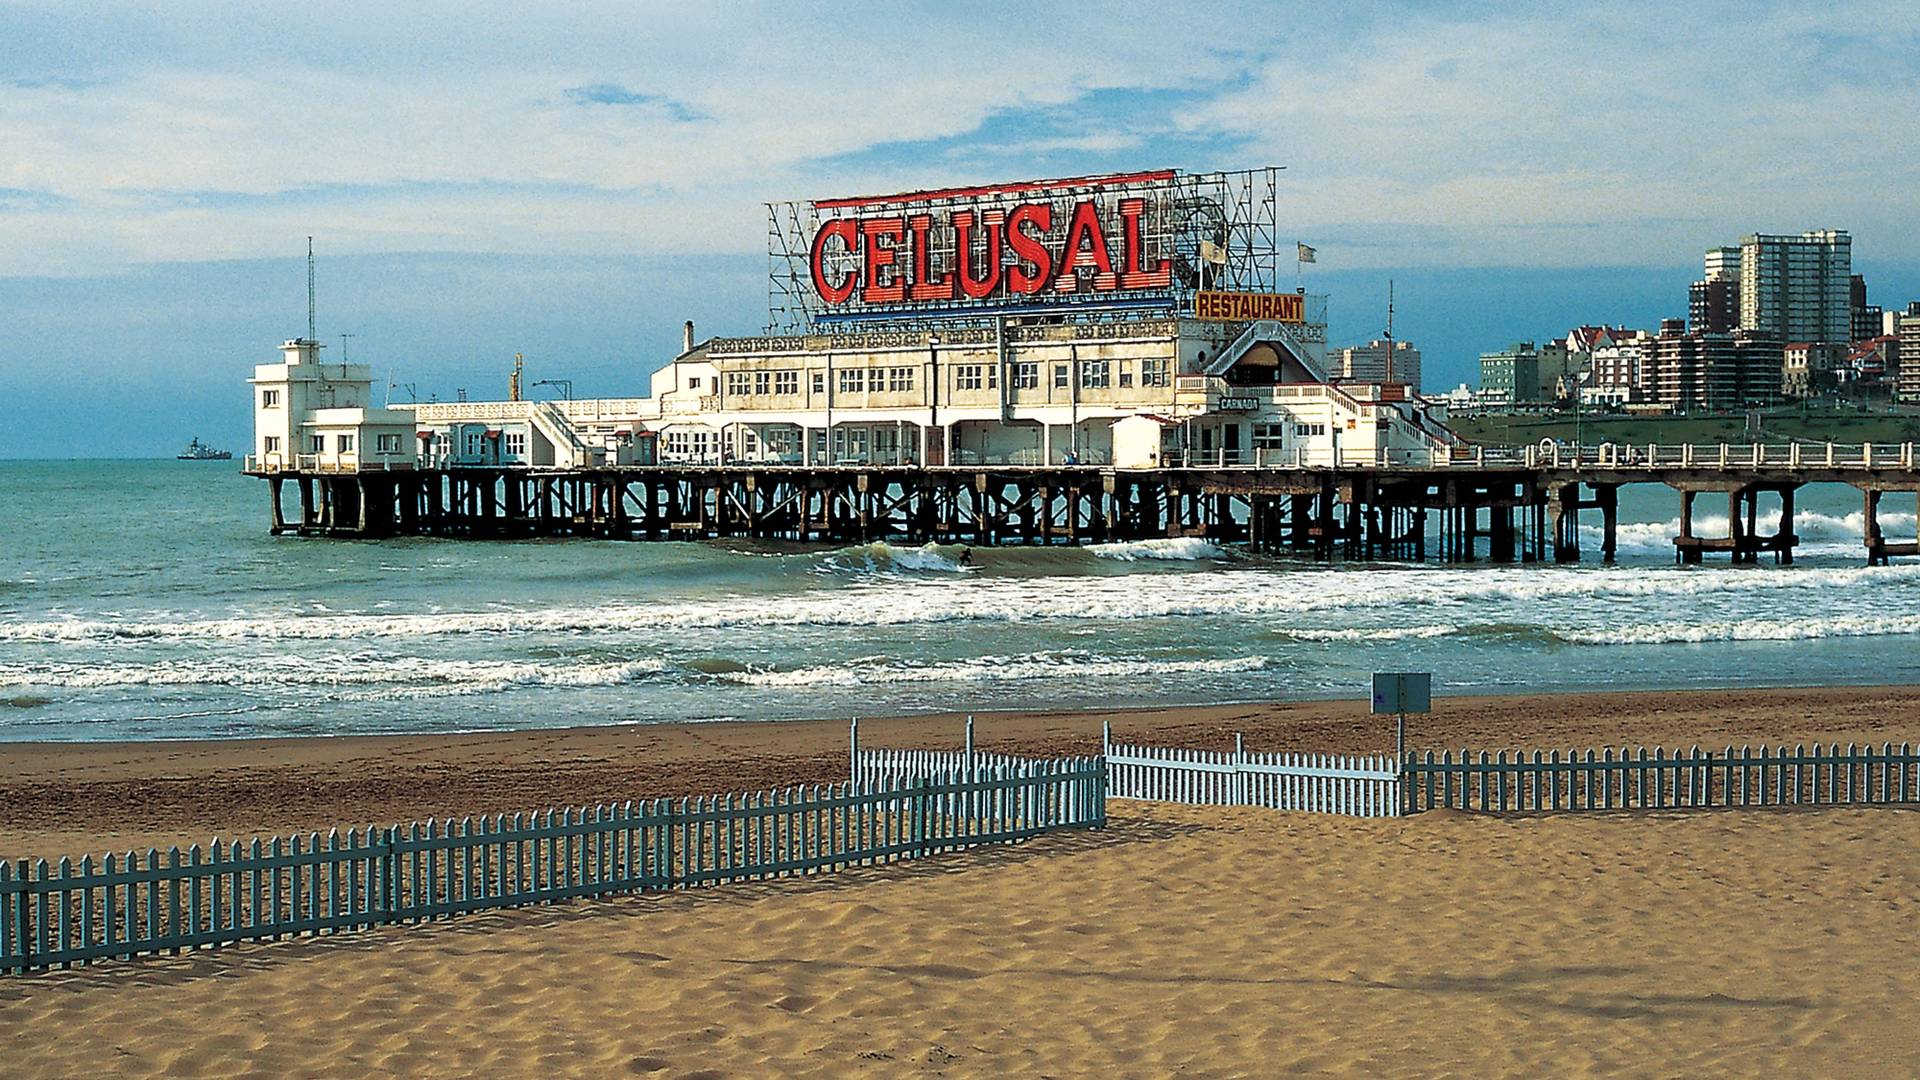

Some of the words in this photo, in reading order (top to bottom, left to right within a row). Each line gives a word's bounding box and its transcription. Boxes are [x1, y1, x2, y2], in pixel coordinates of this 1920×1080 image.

[811, 199, 1170, 303] CELUSAL
[1199, 294, 1303, 319] RESTAURANT
[1221, 399, 1258, 410] CARNADA
